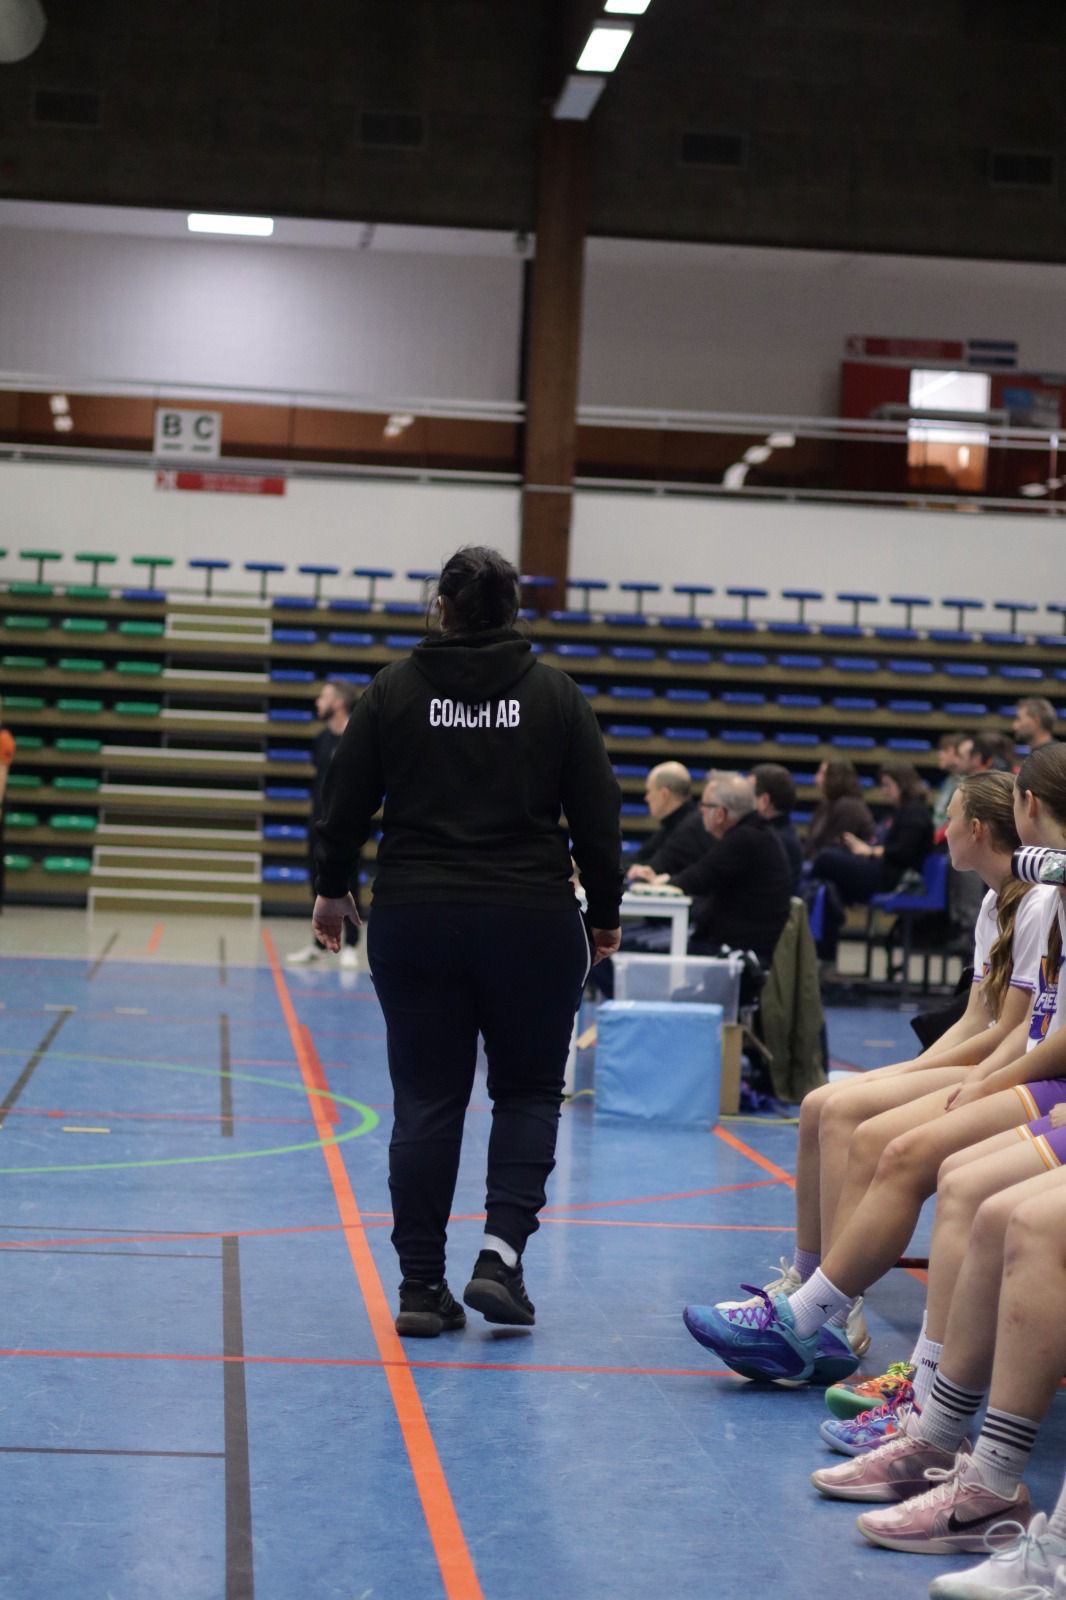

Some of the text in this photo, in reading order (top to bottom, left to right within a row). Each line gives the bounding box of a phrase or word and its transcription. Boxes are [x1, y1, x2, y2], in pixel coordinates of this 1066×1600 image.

[163, 414, 214, 440] B C
[429, 698, 521, 728] COACH AB
